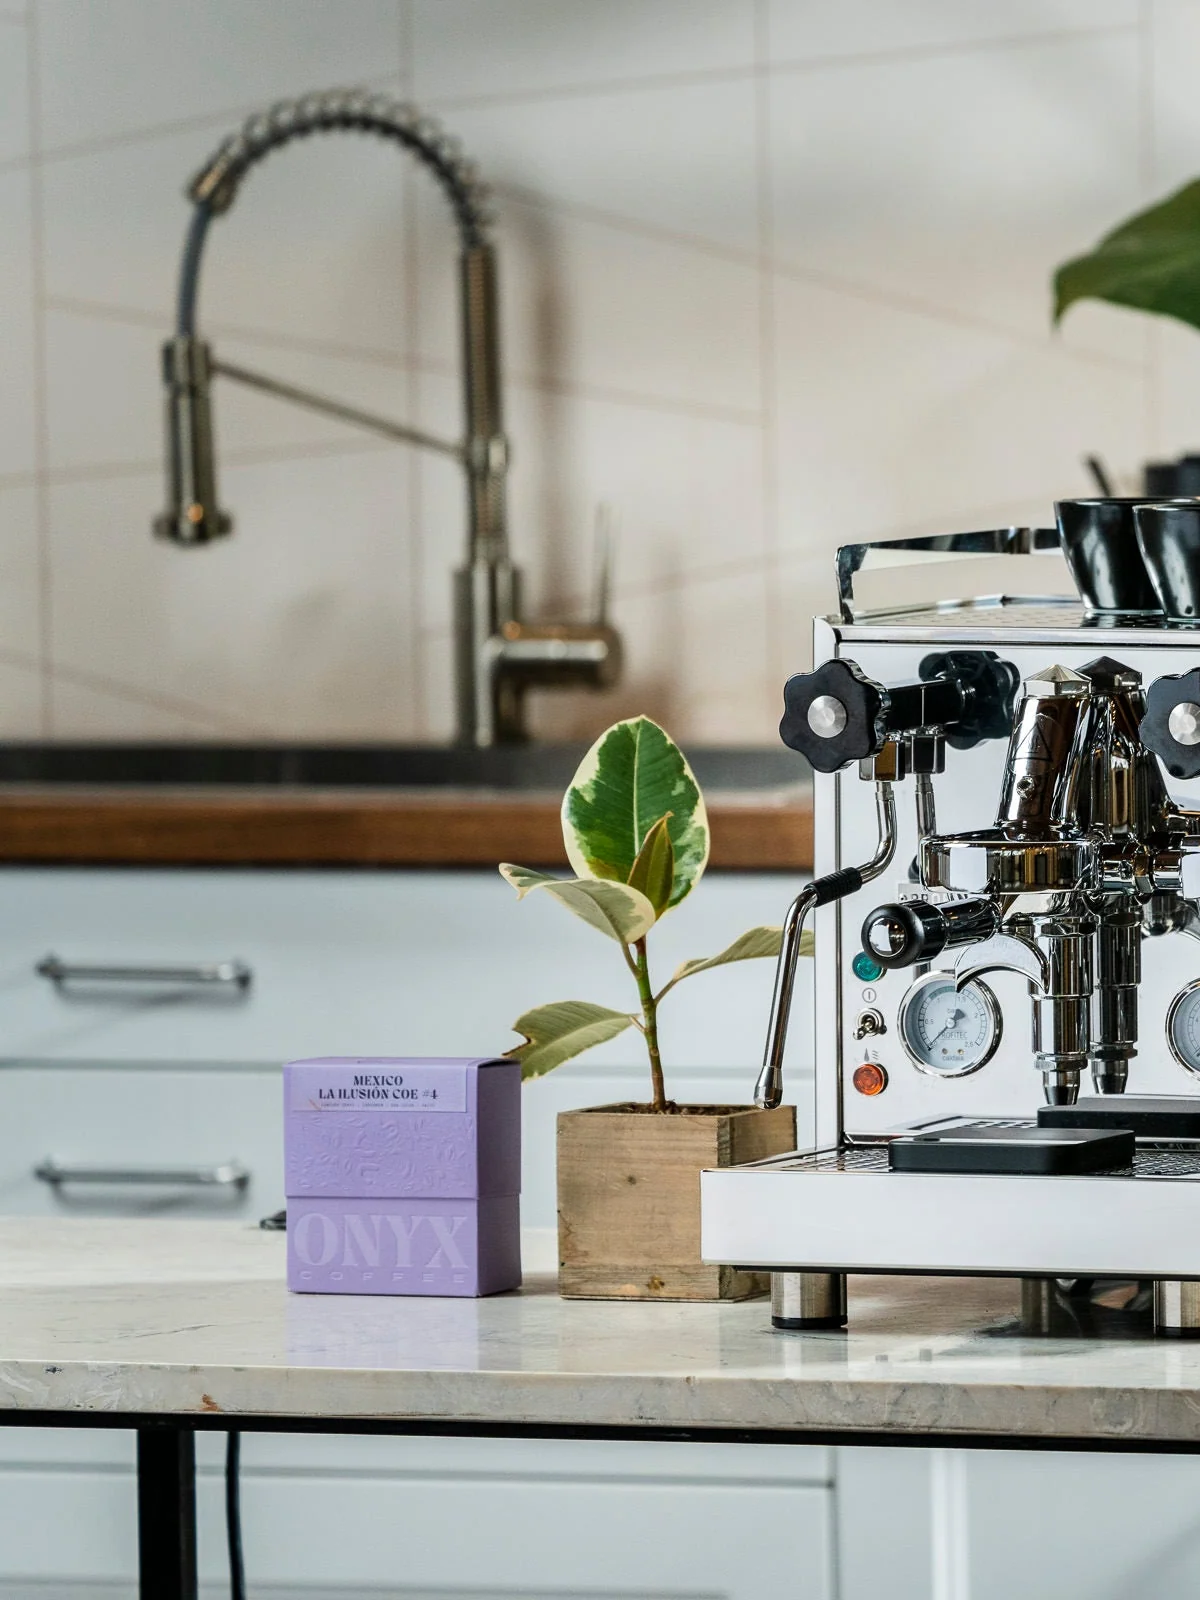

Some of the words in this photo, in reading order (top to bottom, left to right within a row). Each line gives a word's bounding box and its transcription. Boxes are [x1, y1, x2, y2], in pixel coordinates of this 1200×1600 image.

[353, 1075, 404, 1087] MEXICO
[319, 1088, 335, 1100] LA
[338, 1086, 389, 1100] ILUSIÓN
[392, 1088, 418, 1100] COE
[422, 1088, 439, 1100] #4
[293, 1212, 469, 1269] ONYX
[300, 1271, 466, 1283] COFFEE
